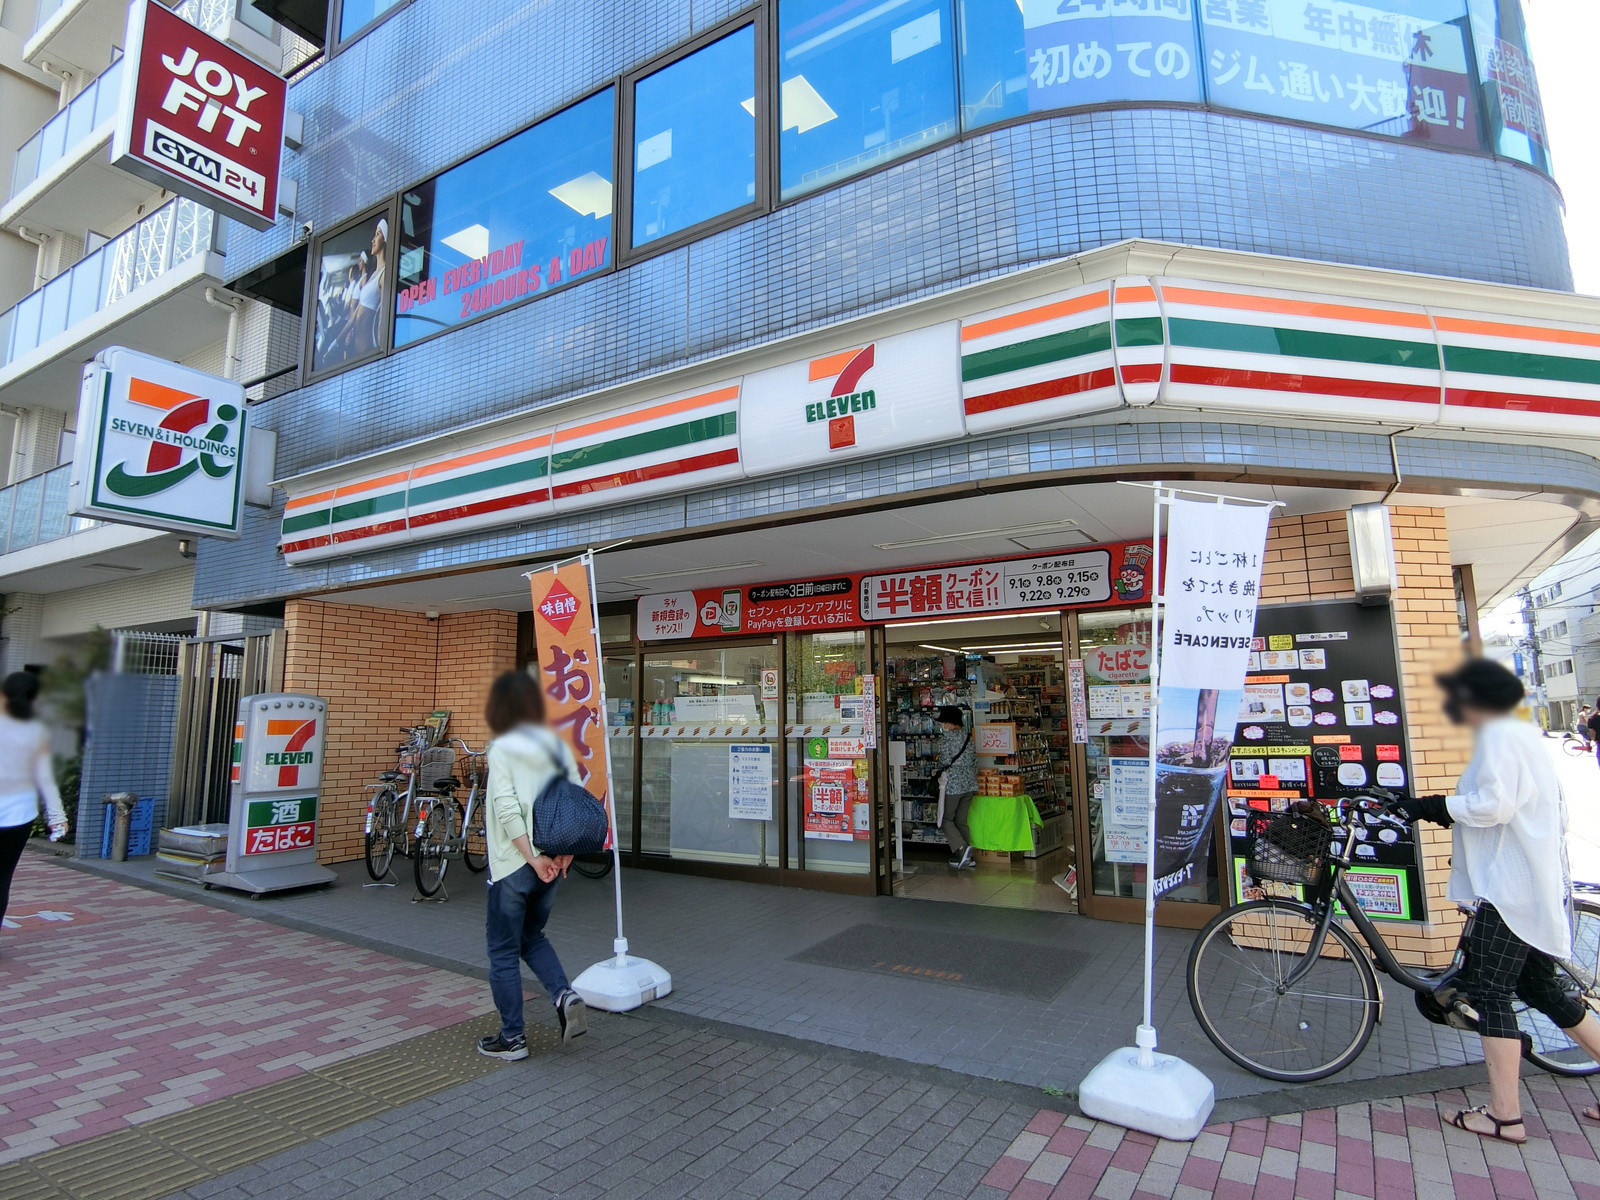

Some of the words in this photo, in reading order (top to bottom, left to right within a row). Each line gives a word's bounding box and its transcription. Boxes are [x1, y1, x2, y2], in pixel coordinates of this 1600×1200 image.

[162, 46, 267, 112] JOY
[156, 138, 219, 181] GYM
[225, 168, 257, 197] 24
[399, 276, 437, 313] OPEN
[443, 239, 525, 296] EVERYDAY
[460, 264, 541, 318] 24HOURS
[548, 256, 561, 284] A
[569, 236, 608, 276] DAY
[173, 433, 236, 458] HOLDINGS
[946, 567, 999, 590] クーポン
[541, 596, 577, 616] 味自慢
[877, 574, 942, 615] 半額
[652, 609, 690, 622] 新規登録の
[1098, 649, 1149, 672] たばこ
[1108, 672, 1139, 680] cigarette
[816, 787, 842, 804] 半額
[271, 801, 302, 825] 酒
[251, 826, 311, 853] たばこ
